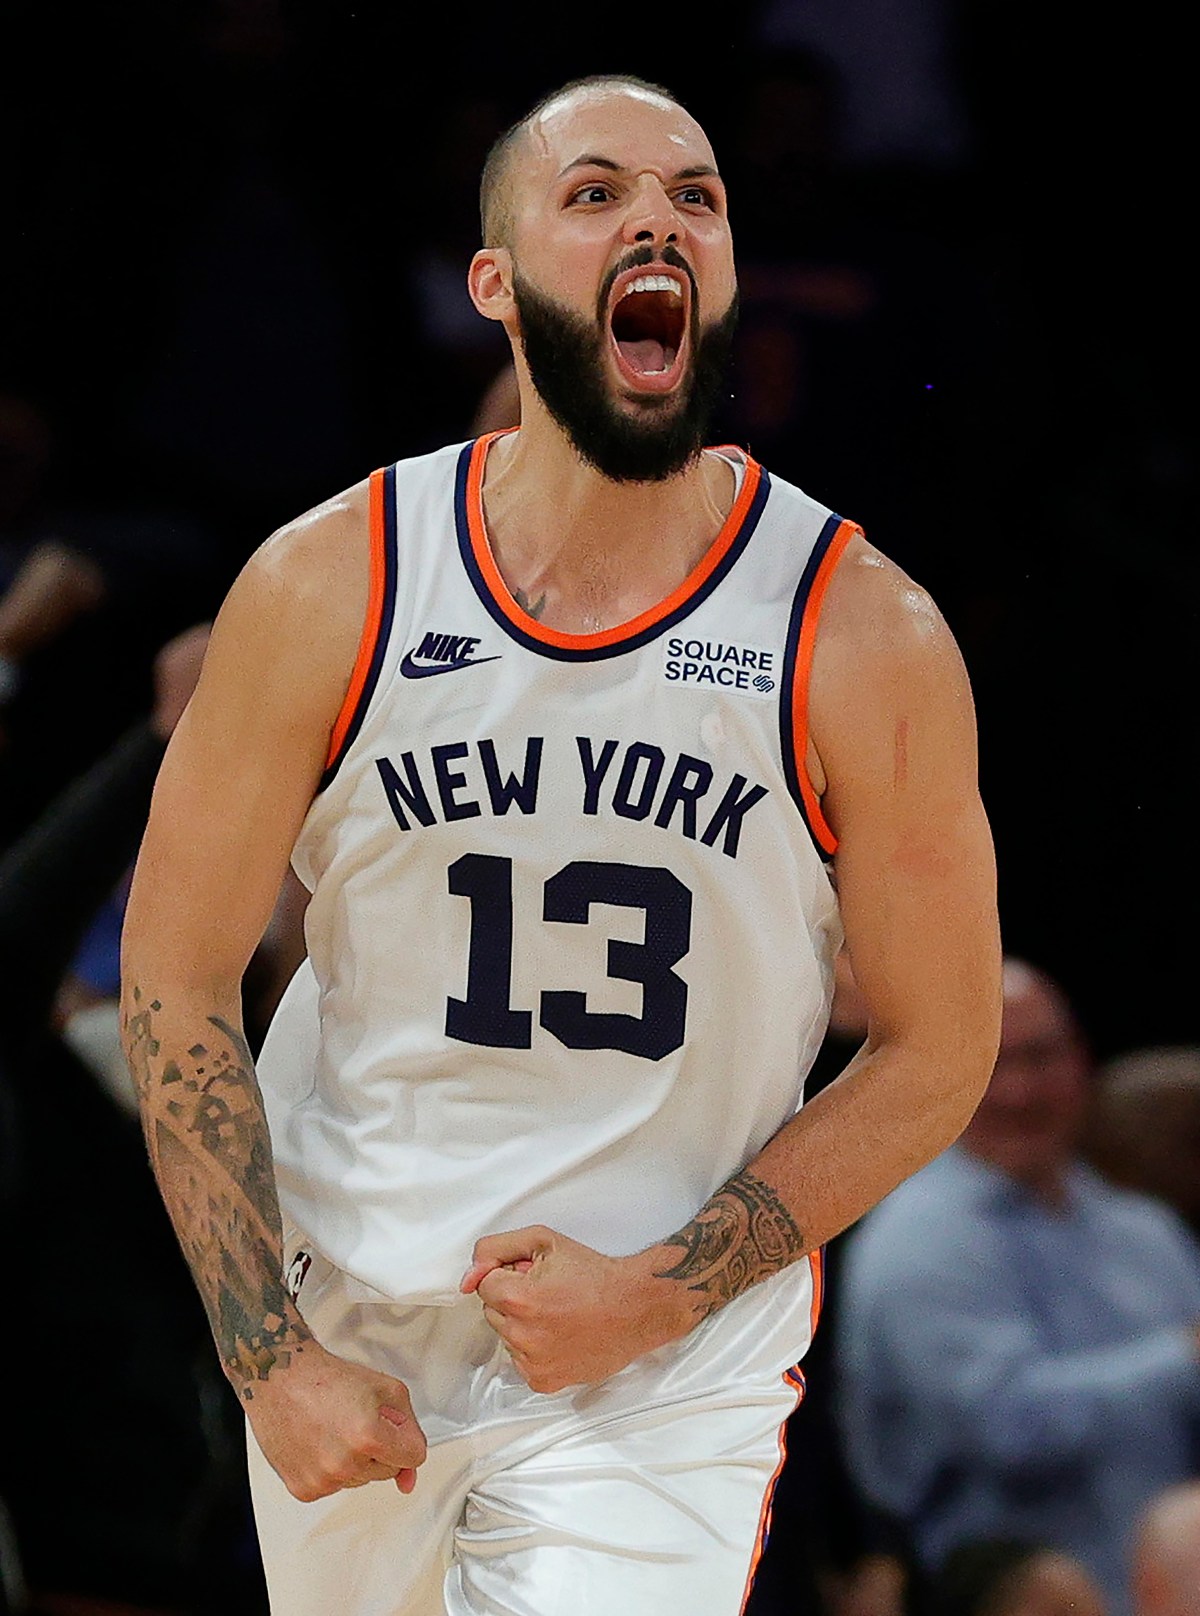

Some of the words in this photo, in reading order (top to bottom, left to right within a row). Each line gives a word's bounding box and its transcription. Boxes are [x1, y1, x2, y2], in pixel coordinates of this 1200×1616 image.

[414, 632, 482, 662] NIKE
[667, 638, 773, 671] SQUARE
[665, 661, 750, 690] SPACE
[376, 737, 544, 831] NEW
[576, 737, 769, 859] YORK
[445, 853, 693, 1061] 13
